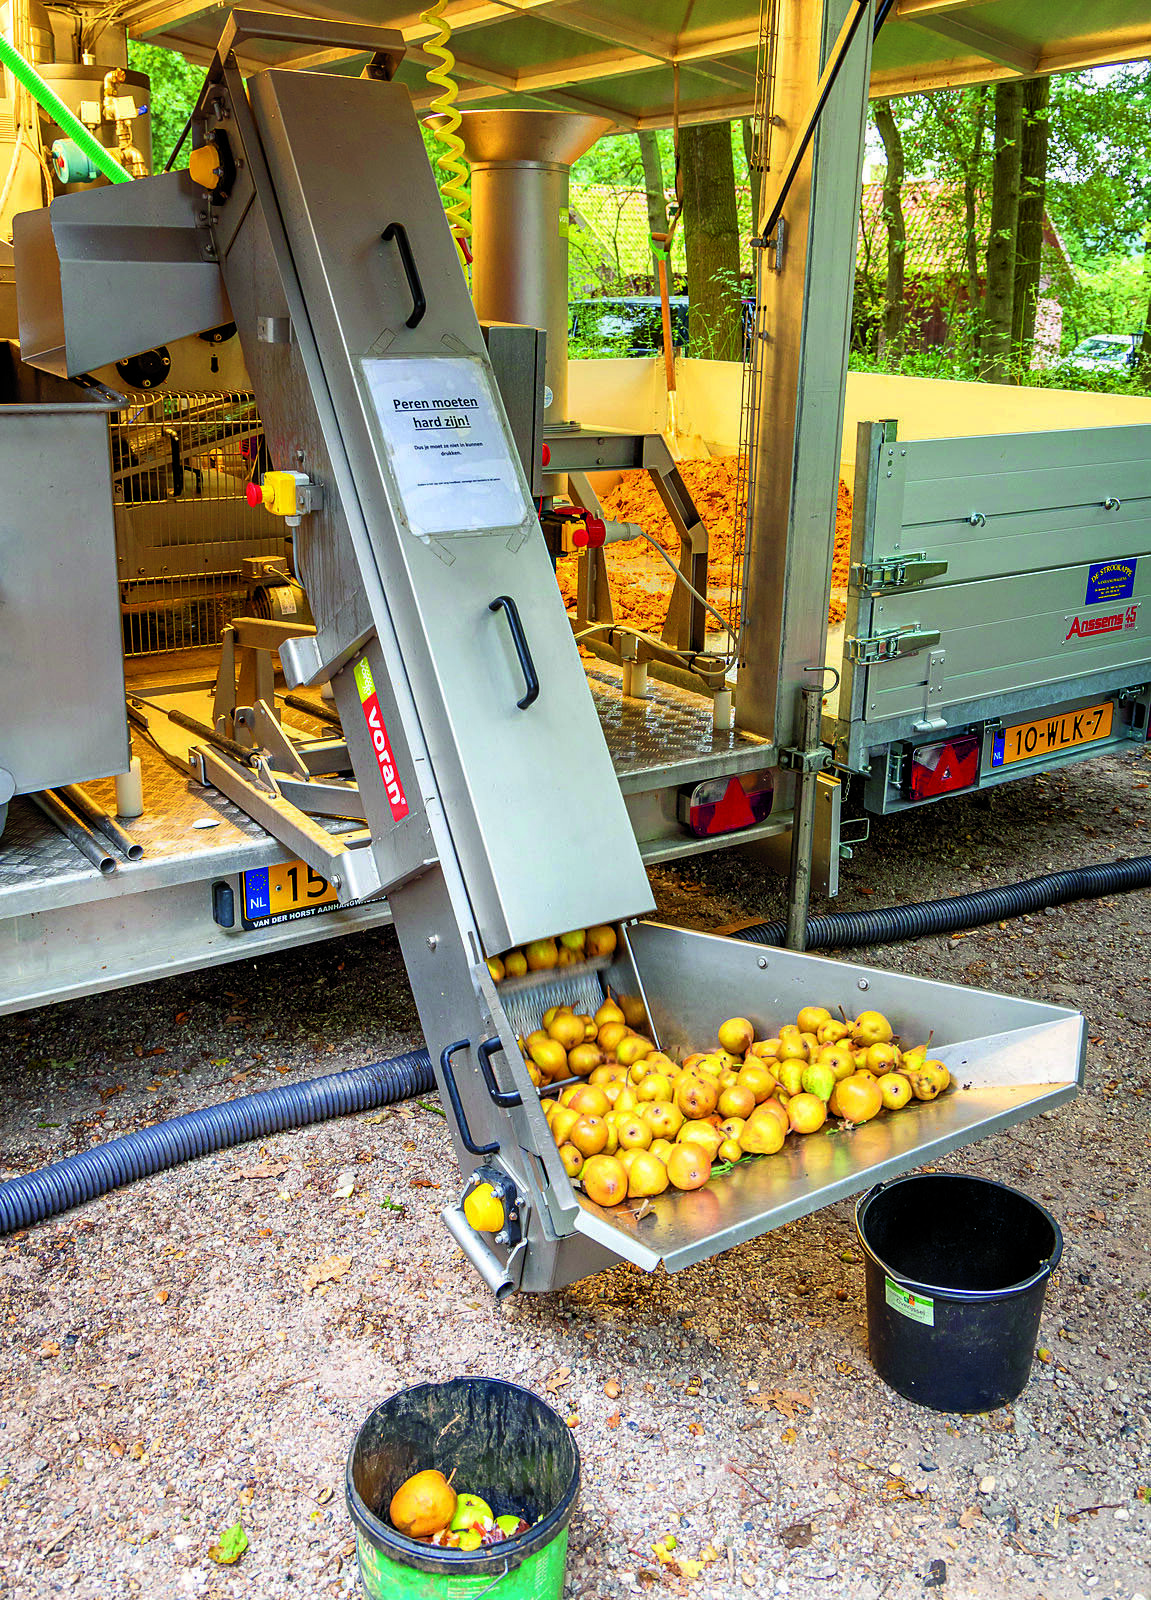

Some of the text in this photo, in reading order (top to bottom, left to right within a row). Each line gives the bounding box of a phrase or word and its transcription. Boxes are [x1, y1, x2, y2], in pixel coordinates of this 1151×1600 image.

[393, 397, 478, 409] Peren moeten
[413, 415, 470, 428] hard zijn!
[1066, 605, 1138, 640] Anssems 45
[993, 709, 1104, 760] NL 10-WLK-7
[250, 896, 267, 909] NL
[252, 918, 270, 928] VAN
[271, 914, 288, 924] DER
[289, 908, 316, 921] HORST
